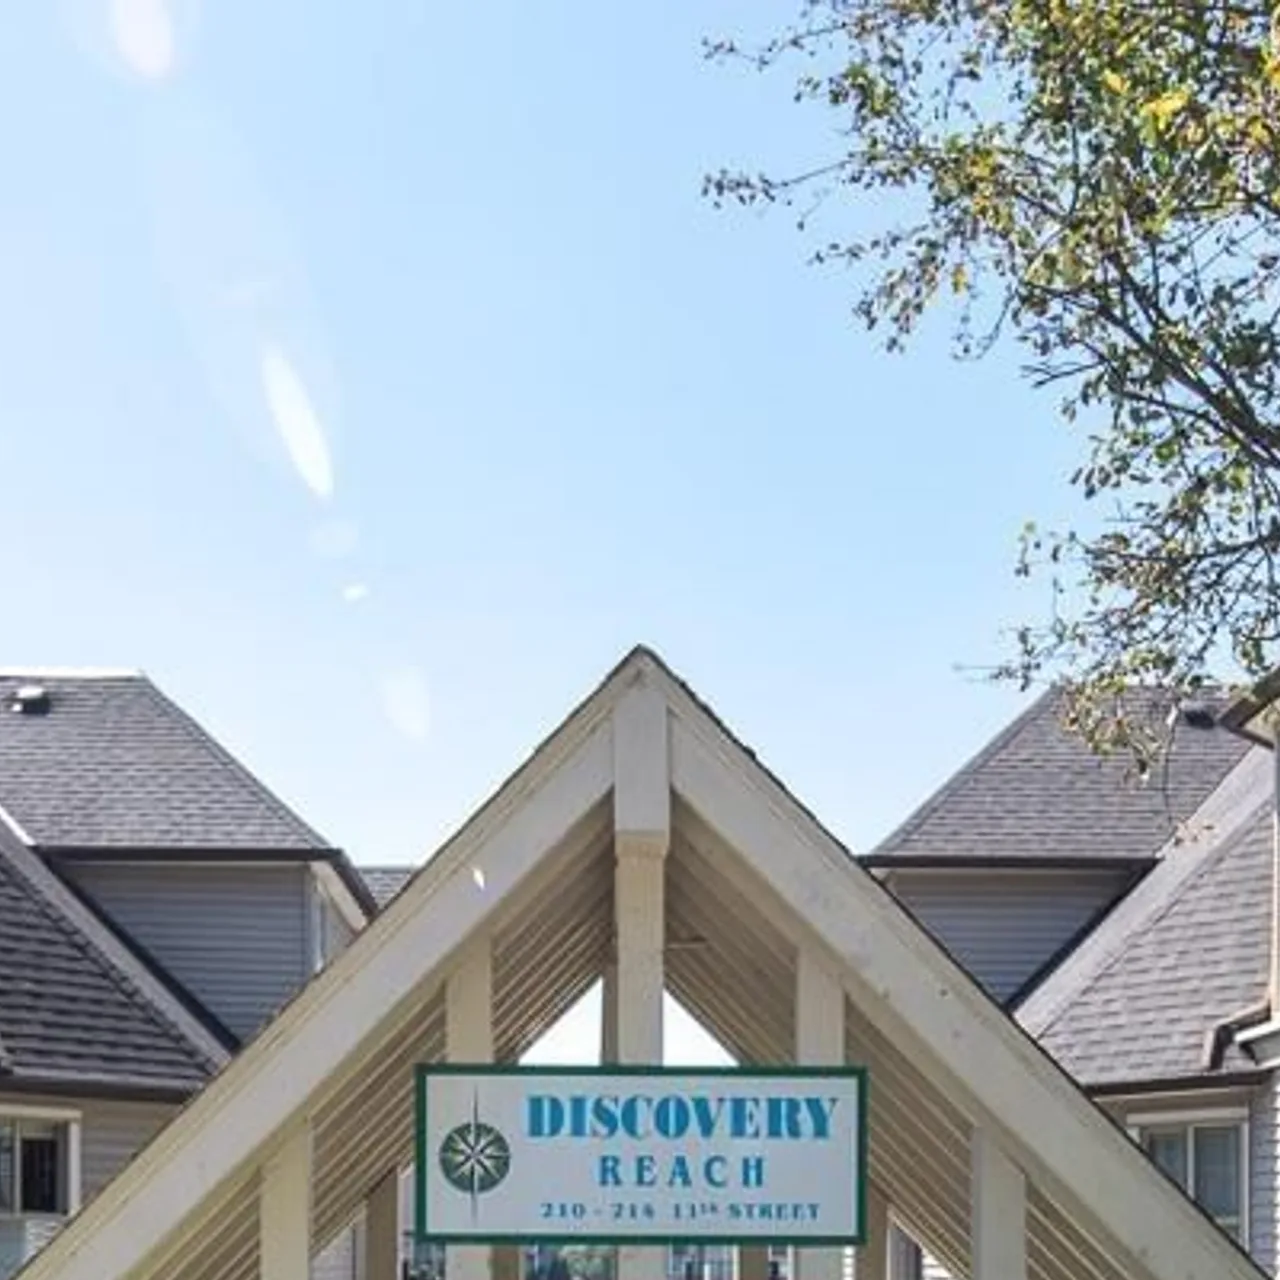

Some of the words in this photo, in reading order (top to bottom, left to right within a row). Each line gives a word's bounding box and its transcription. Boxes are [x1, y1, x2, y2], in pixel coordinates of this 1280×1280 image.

[526, 1095, 838, 1139] DISCOVERY
[598, 1155, 765, 1188] REACH
[540, 1202, 587, 1220] 210
[728, 1202, 820, 1220] STREET
